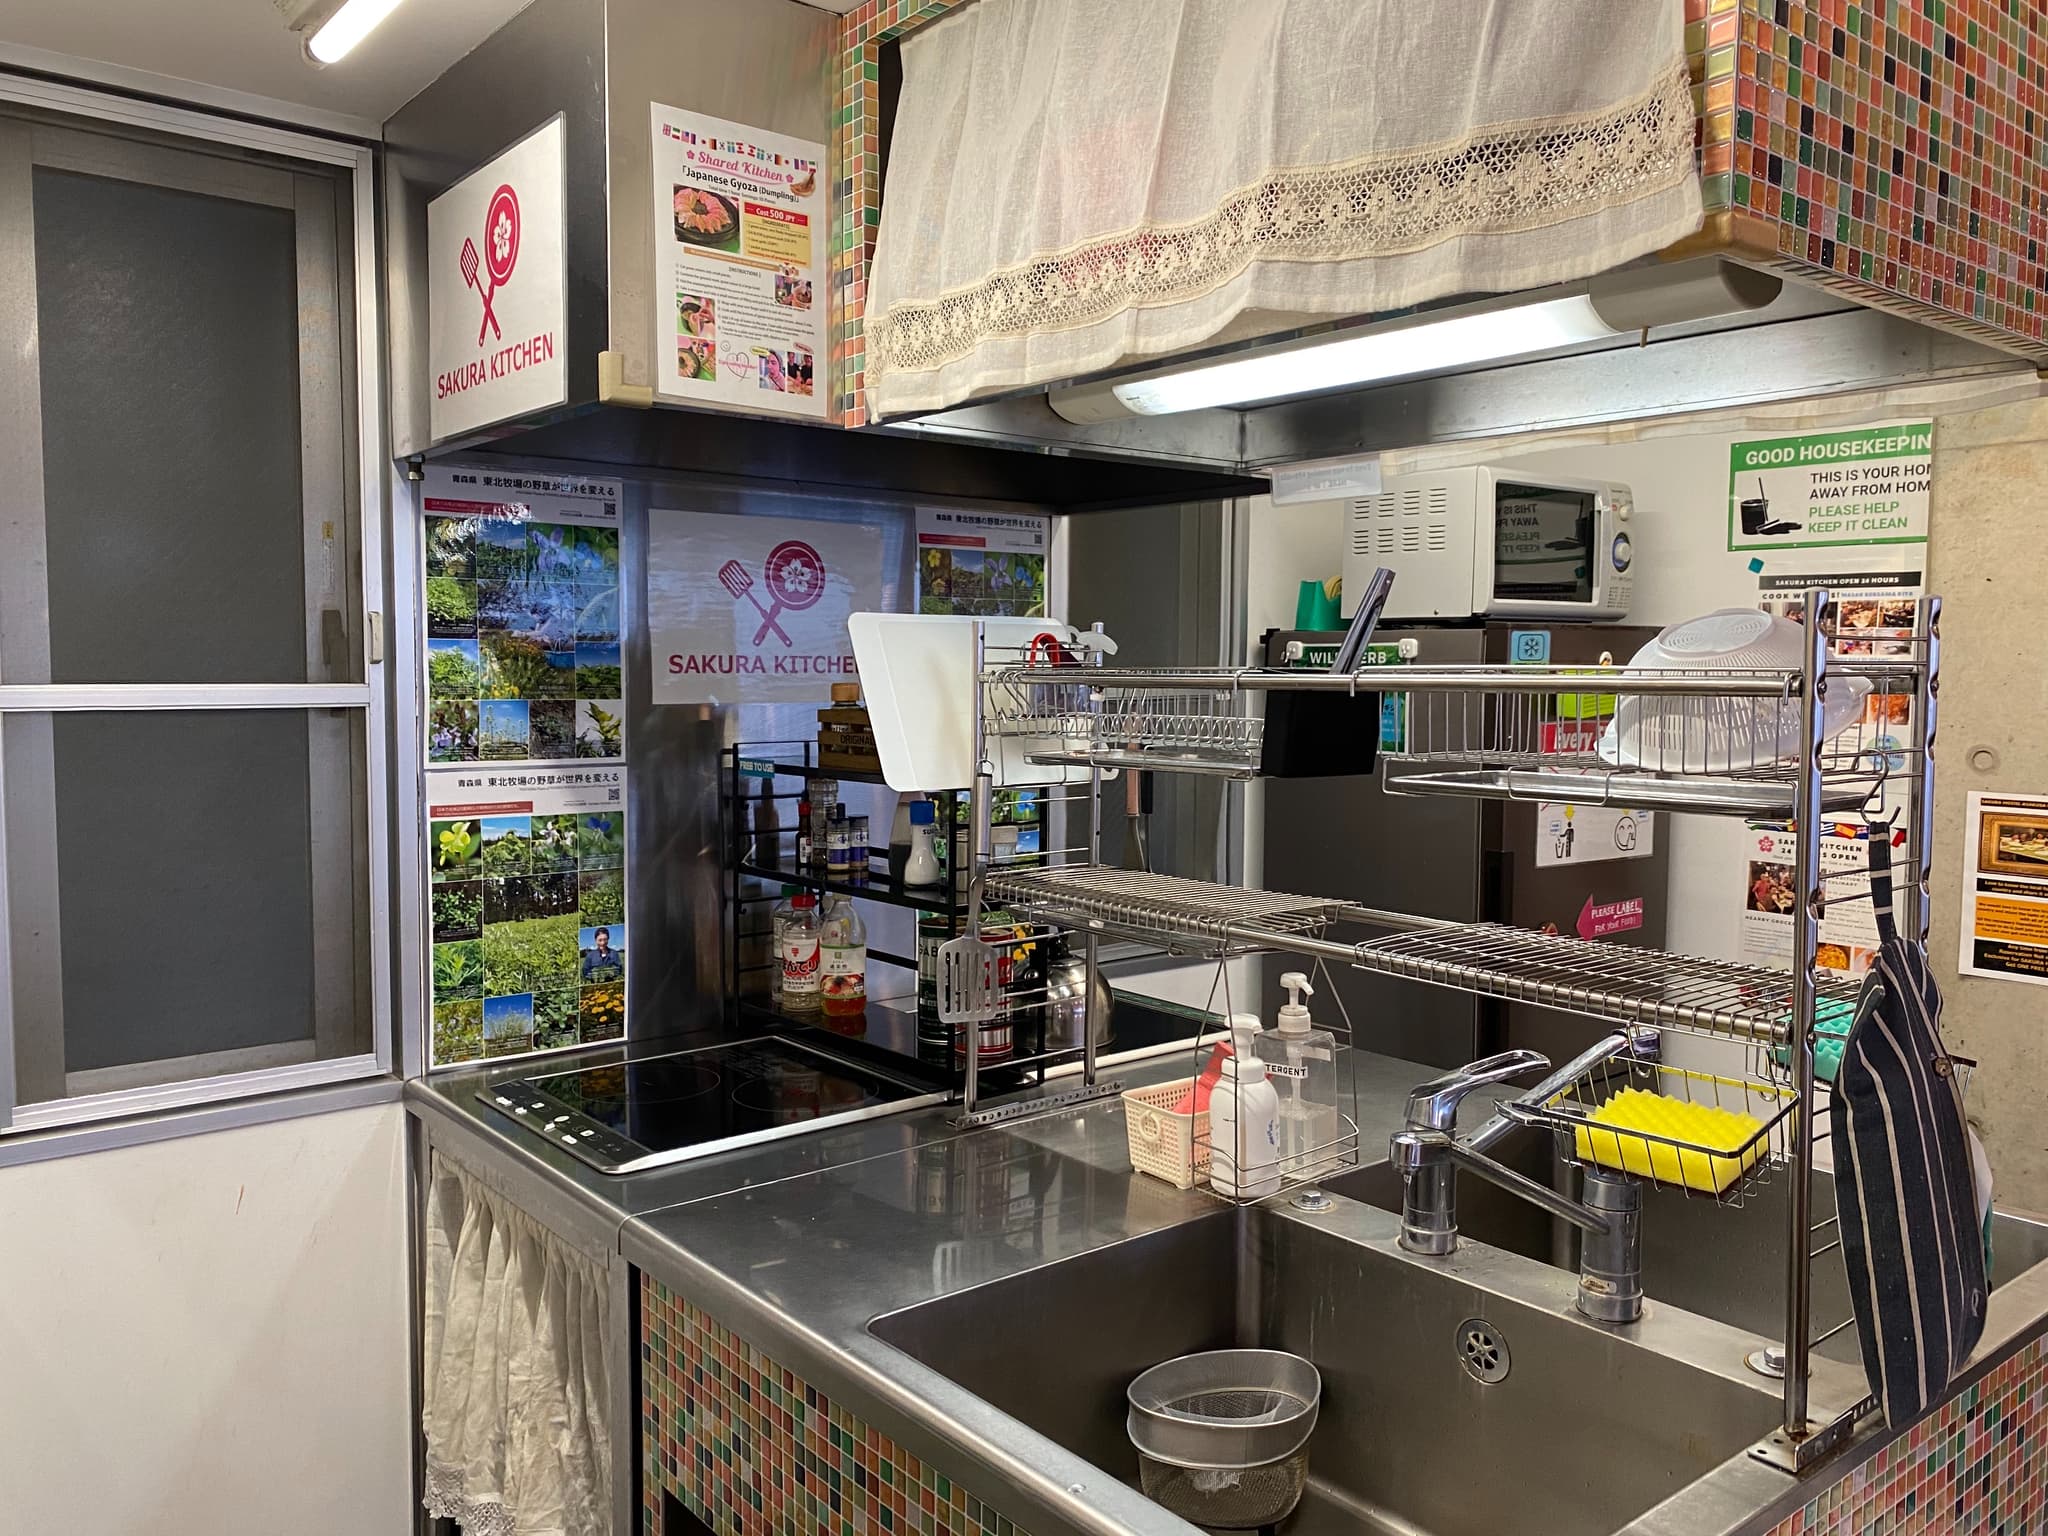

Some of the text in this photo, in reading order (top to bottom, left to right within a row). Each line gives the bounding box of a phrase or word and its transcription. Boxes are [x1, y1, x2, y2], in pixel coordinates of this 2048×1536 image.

[698, 151, 784, 182] Shared Kitchen
[730, 177, 758, 193] Gyoza
[769, 207, 784, 220] 500
[437, 331, 554, 399] SAKURA KITCHEN
[1746, 433, 1931, 465] GOOD HOUSEKEEPIN
[1810, 463, 1931, 484] THIS IS YOUR HO
[1809, 480, 1931, 500] AWAY FROM HOM
[1809, 501, 1900, 518] PLEASE HELP
[1808, 516, 1908, 533] KEEP IT CLEAN
[1839, 577, 1860, 585] OPEN
[1871, 576, 1899, 584] HOURS
[668, 654, 855, 675] SAKURA KITCHE
[1309, 651, 1387, 664] WIL ERB
[739, 760, 775, 773] FREE TO USE
[457, 773, 620, 787] 青森県 東北牧場の野草が世界を変える
[1830, 852, 1858, 861] OPEN
[1591, 900, 1640, 919] PLEASE LABEL
[1265, 1064, 1306, 1076] TERGENT
